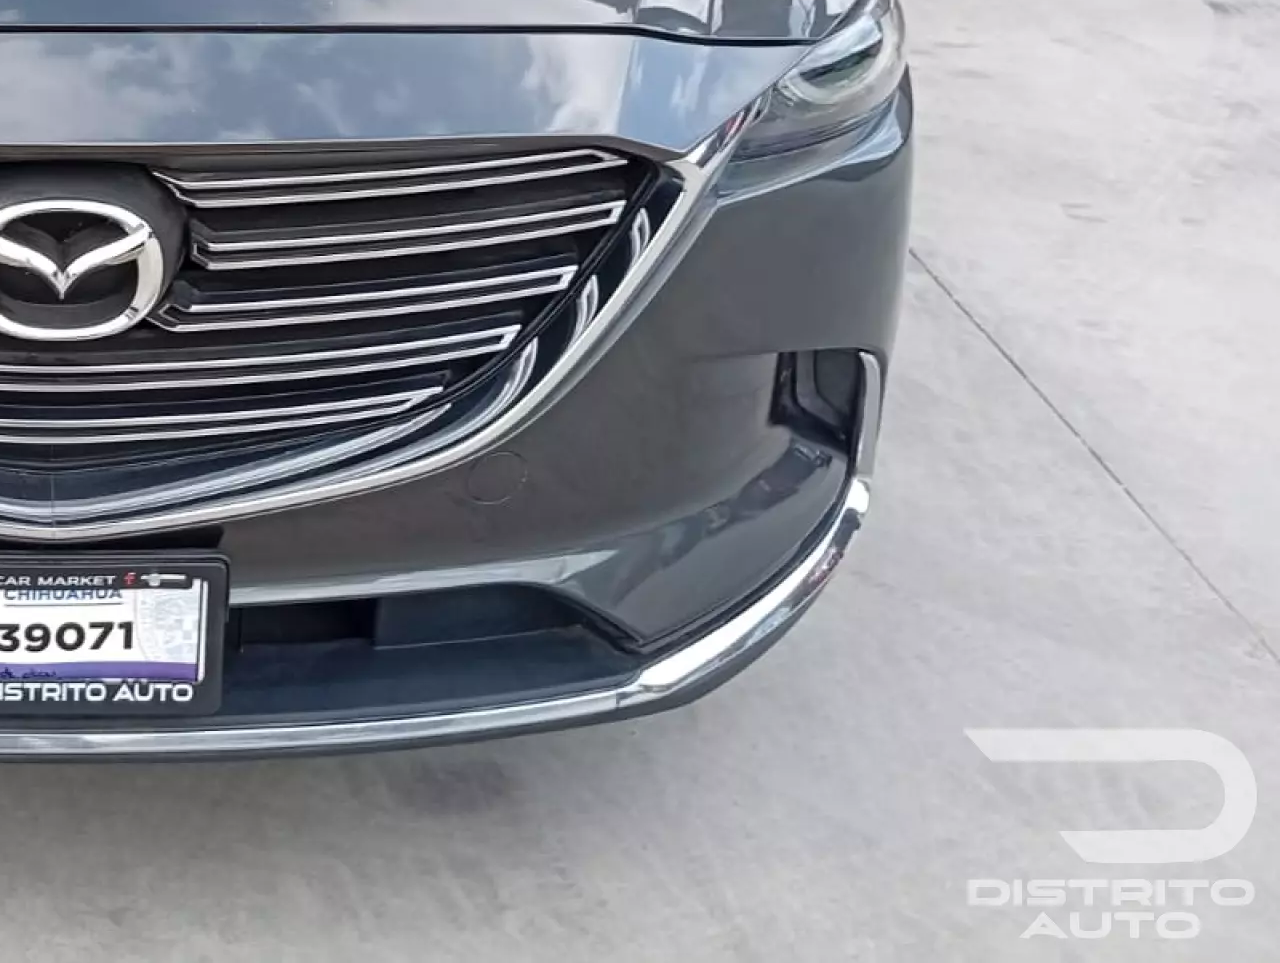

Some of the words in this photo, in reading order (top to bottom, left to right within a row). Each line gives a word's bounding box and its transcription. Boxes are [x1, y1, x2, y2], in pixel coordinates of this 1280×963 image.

[37, 575, 117, 586] MARKET
[3, 588, 124, 601] CHIHUAHUA
[112, 682, 194, 702] AUTO
